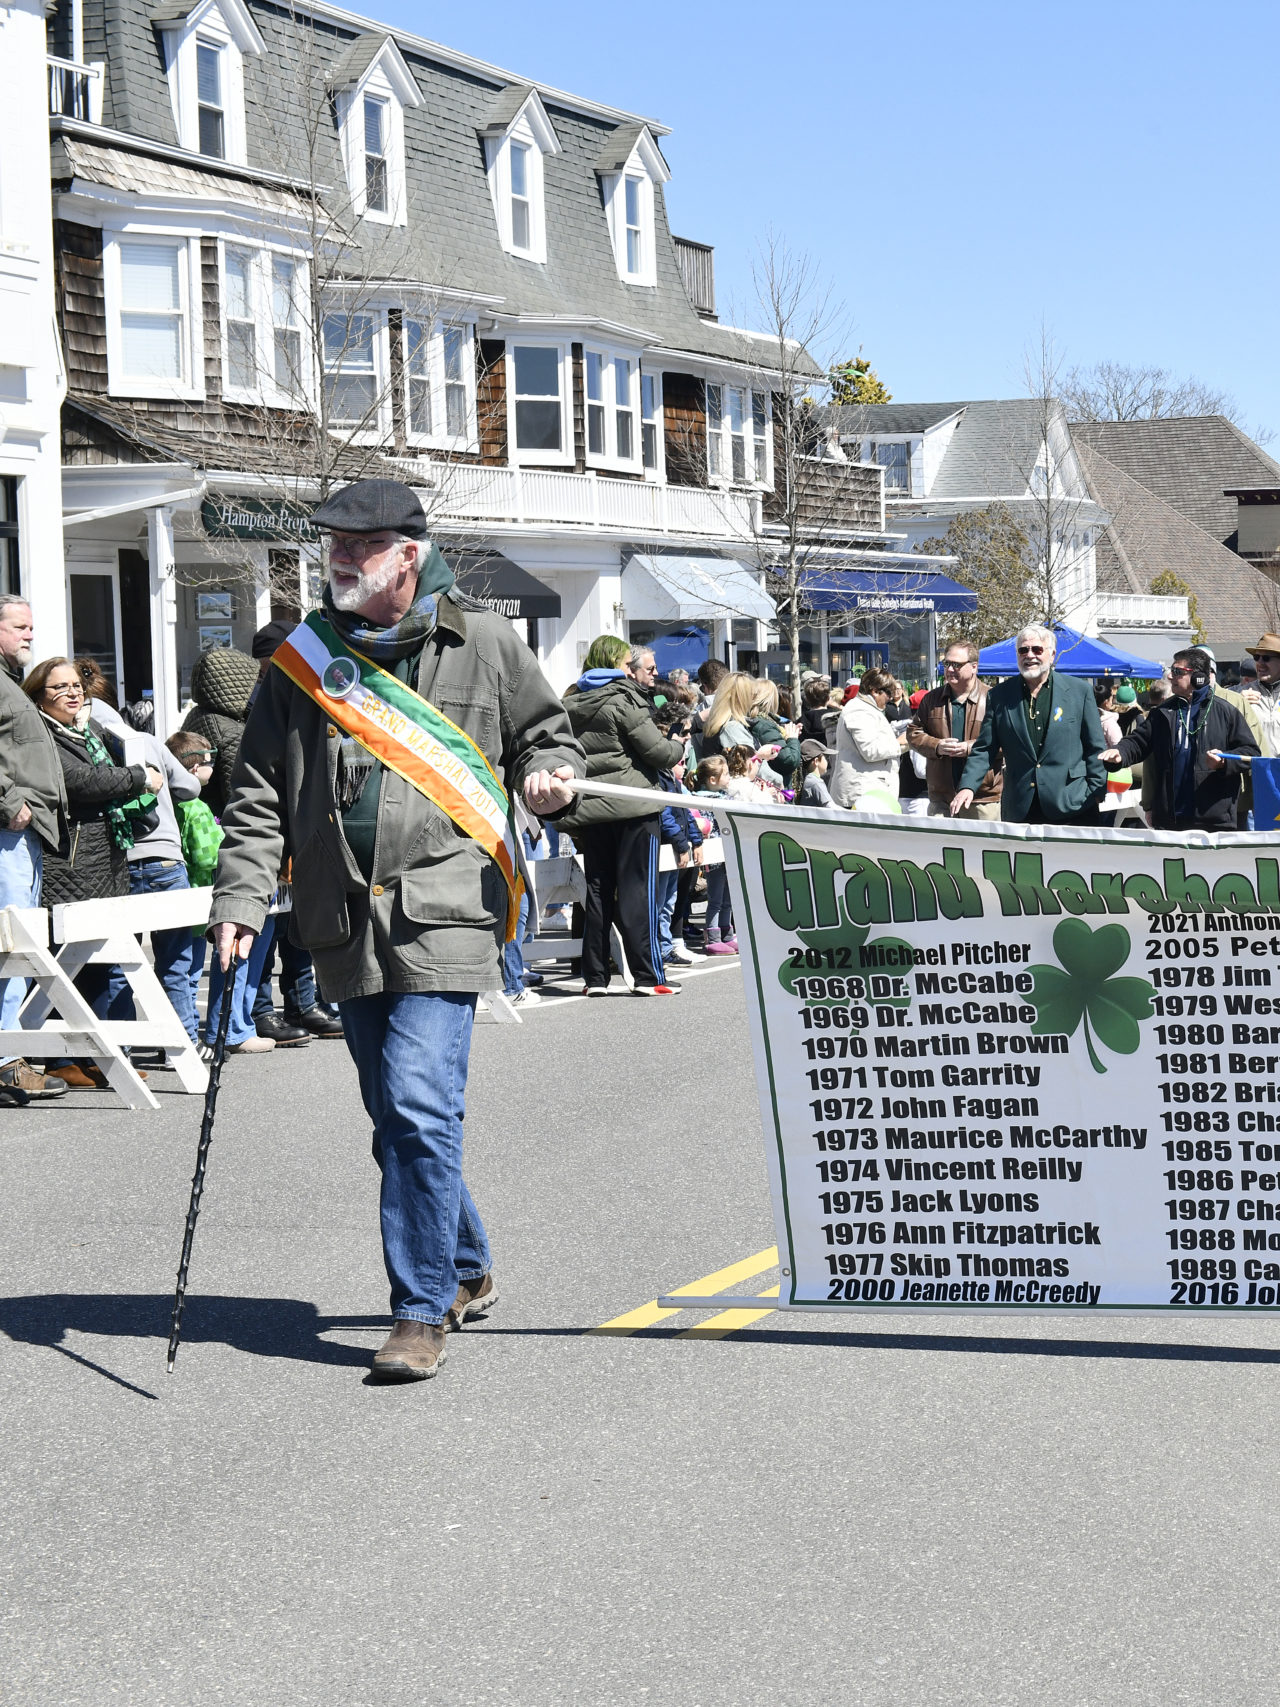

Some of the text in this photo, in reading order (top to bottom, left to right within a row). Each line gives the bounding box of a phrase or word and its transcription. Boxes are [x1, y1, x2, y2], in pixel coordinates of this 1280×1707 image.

[221, 504, 275, 531] Hampton
[361, 695, 407, 735] GRAND
[406, 731, 471, 789] MARSHAL
[759, 831, 984, 931] Grand
[1144, 937, 1220, 960] 2005
[793, 970, 1033, 999] 1968 Dr. McCabe
[1147, 966, 1215, 988] 1978
[1222, 965, 1272, 987] Jim
[797, 1001, 1036, 1029] 1969 Dr. McCabe
[1150, 994, 1218, 1017] 1979
[801, 1032, 1069, 1060] 1970 Martin Brown
[1152, 1024, 1225, 1046] 1980
[1155, 1053, 1221, 1074] 1981
[805, 1063, 1041, 1091] 1971 Tom Garrity
[1157, 1082, 1228, 1104] 1982
[808, 1095, 1039, 1122] 1972 John Fagan
[1159, 1111, 1230, 1133] 1983
[812, 1124, 1148, 1152] 1973 Maurice McCarthy
[1161, 1140, 1232, 1162] 1985
[815, 1157, 1083, 1183] 1974 Vincent Reilly
[1163, 1169, 1234, 1191] 1986
[818, 1189, 1040, 1215] 1975 Jack Lyons
[1164, 1199, 1230, 1221] 1987
[820, 1221, 1101, 1247] 1976 Ann Fitzpatrick
[1165, 1228, 1236, 1251] 1988
[824, 1252, 1070, 1279] 1977 Skip Thomas
[1166, 1258, 1237, 1281] 1989
[1169, 1281, 1239, 1305] 2016
